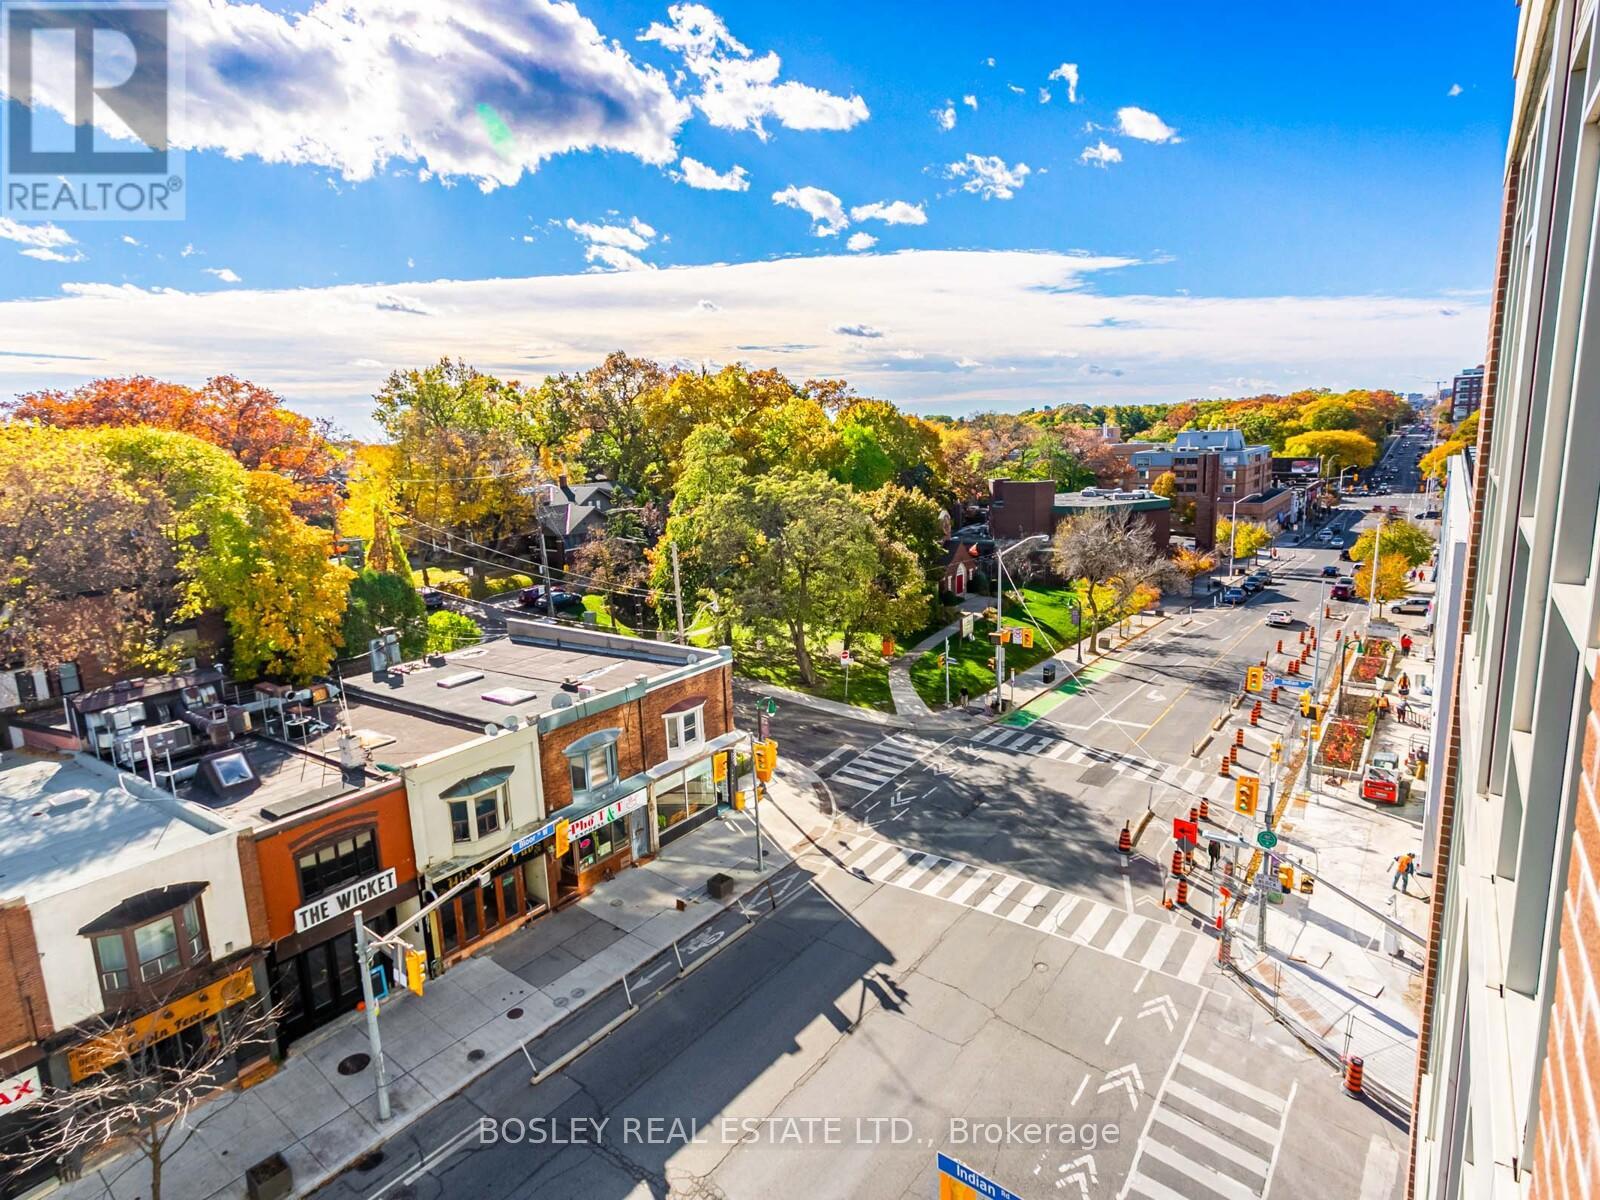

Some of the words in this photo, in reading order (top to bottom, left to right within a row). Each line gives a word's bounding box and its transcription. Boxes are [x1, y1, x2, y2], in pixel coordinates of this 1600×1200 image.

[299, 901, 330, 928] THE
[336, 872, 395, 911] WICKET
[174, 1008, 209, 1030] Fever
[956, 1164, 996, 1197] Indian
[1001, 1190, 1011, 1200] Rd
